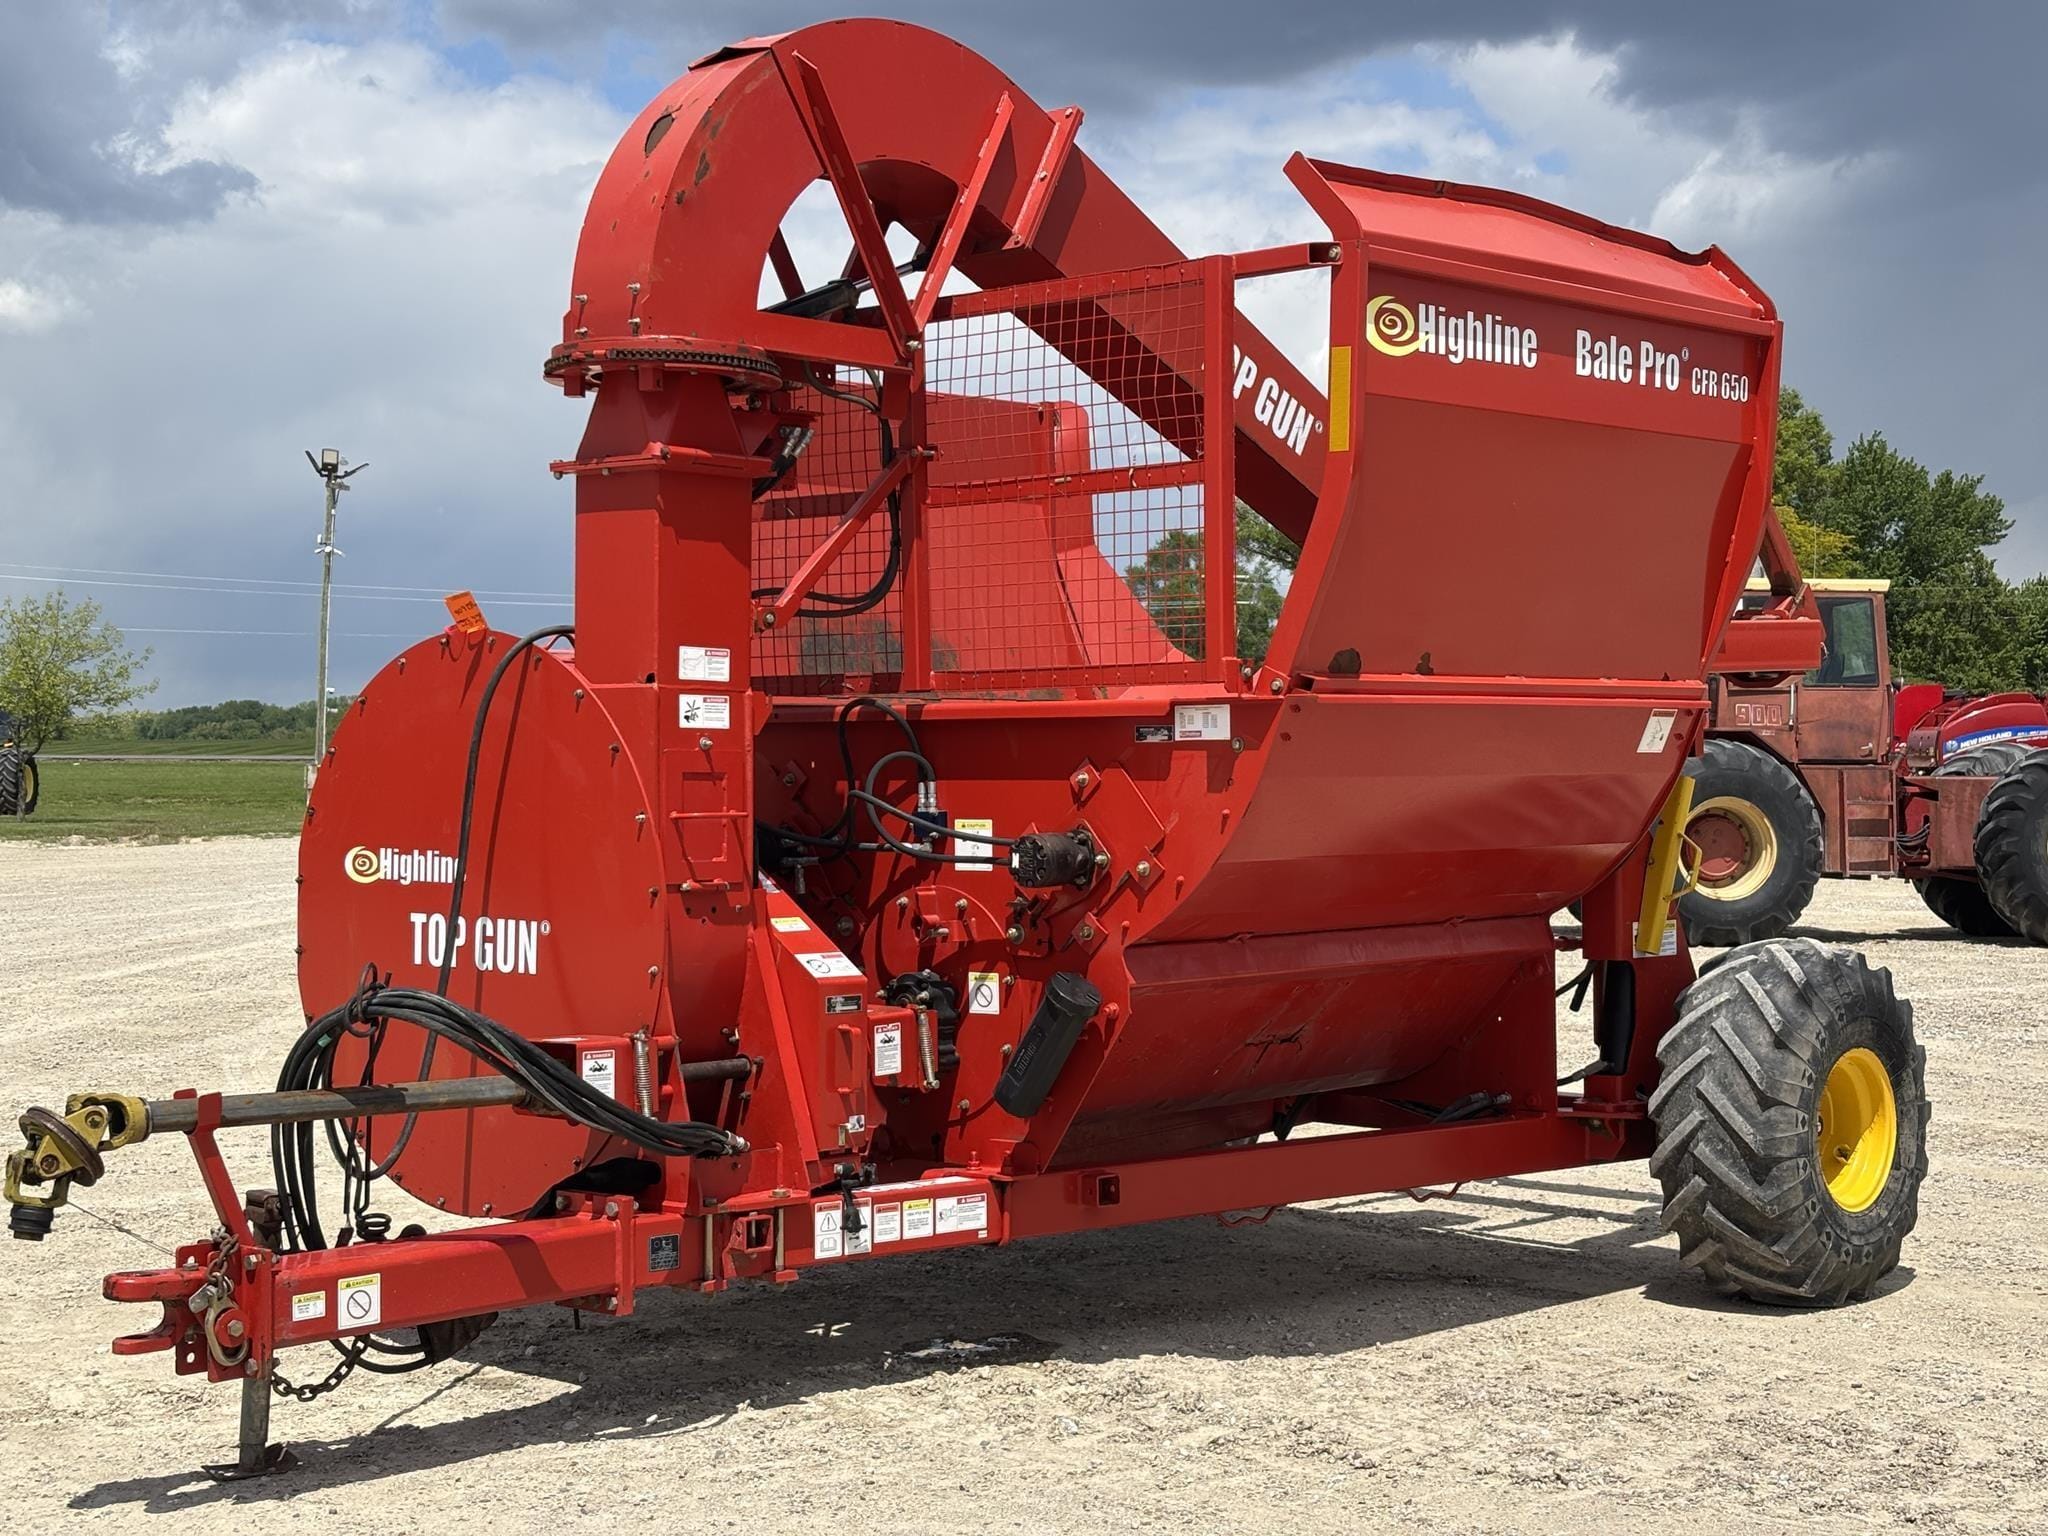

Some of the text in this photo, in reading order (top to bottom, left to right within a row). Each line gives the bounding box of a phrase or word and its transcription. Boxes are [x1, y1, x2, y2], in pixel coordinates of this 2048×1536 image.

[1418, 303, 1538, 368] Highline
[1575, 329, 1633, 384] Bale
[1691, 367, 1749, 402] CFR 650
[1735, 703, 1782, 727] 900
[1960, 739, 1978, 749] NEW
[1979, 731, 2012, 744] HOLLAND
[410, 912, 467, 968] TOP
